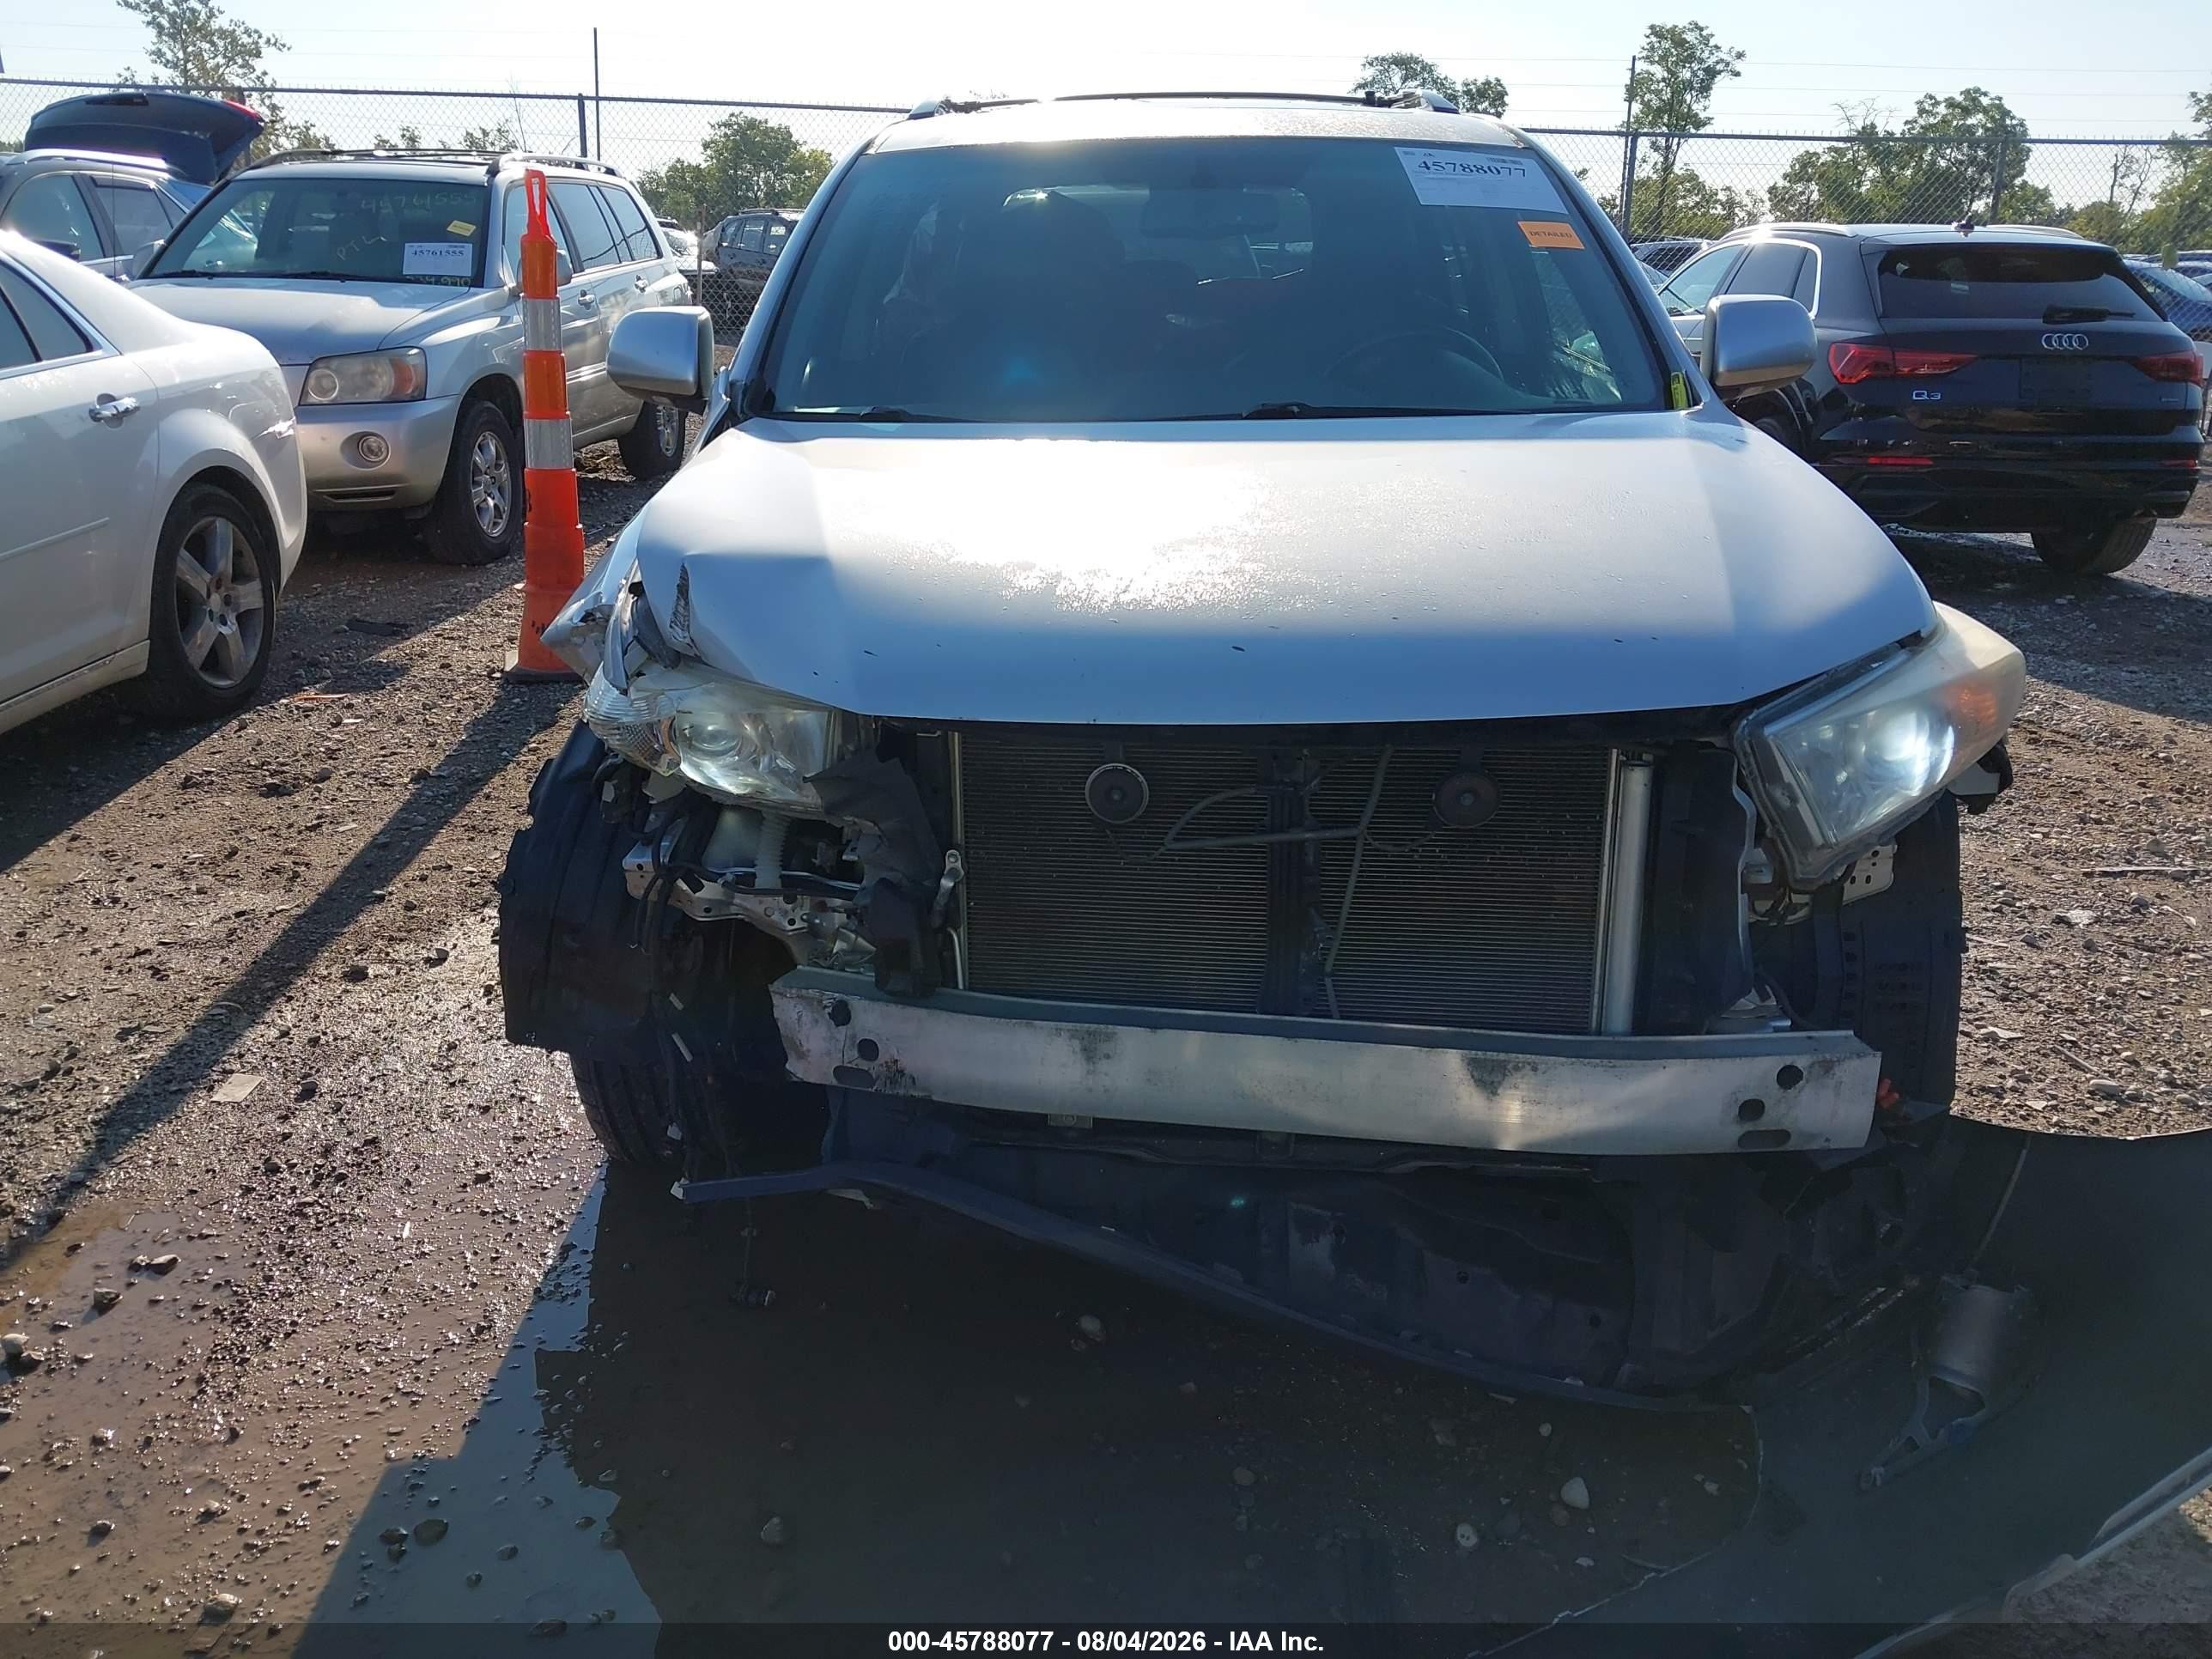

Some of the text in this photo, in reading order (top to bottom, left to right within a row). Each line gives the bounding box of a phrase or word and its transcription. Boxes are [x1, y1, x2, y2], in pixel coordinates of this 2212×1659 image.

[1418, 160, 1526, 178] 45788077
[1528, 230, 1573, 239] DETAILED
[1912, 390, 1942, 400] Q3
